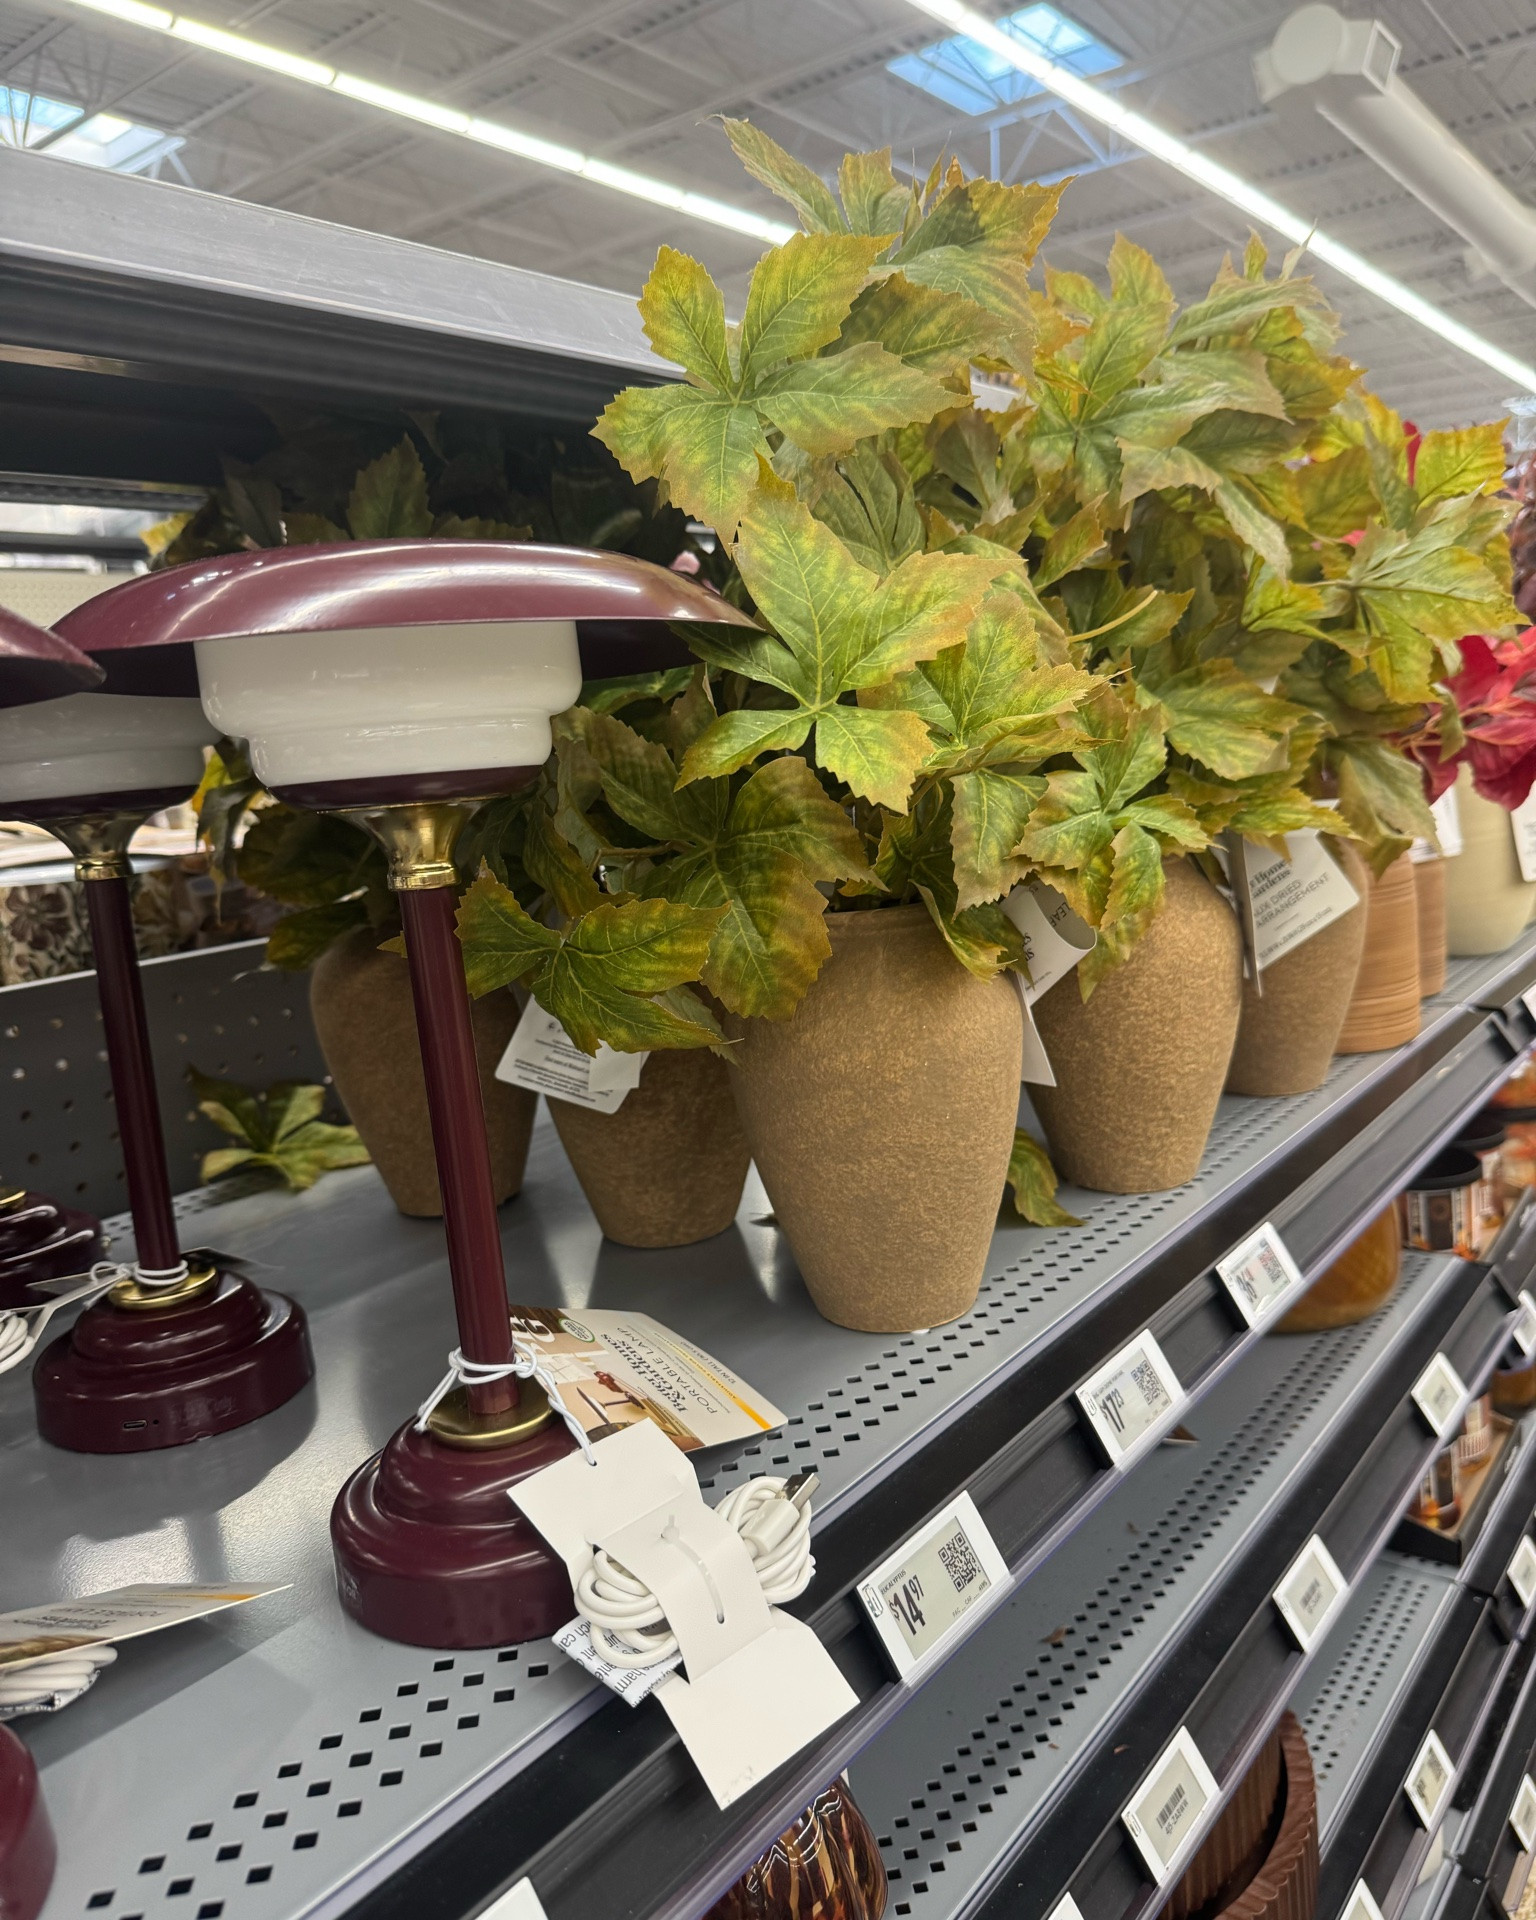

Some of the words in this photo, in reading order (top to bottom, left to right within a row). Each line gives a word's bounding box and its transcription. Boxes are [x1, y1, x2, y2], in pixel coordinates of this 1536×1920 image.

[1256, 871, 1329, 929] ARRANGEMENT
[1270, 880, 1302, 905] DRIED
[601, 1334, 647, 1375] Homes
[617, 1327, 654, 1354] LAMP
[617, 1339, 673, 1390] Gardens
[645, 1376, 688, 1412] Better
[653, 1357, 718, 1414] PORTABLE
[880, 1568, 907, 1596] EUCALYPTUS
